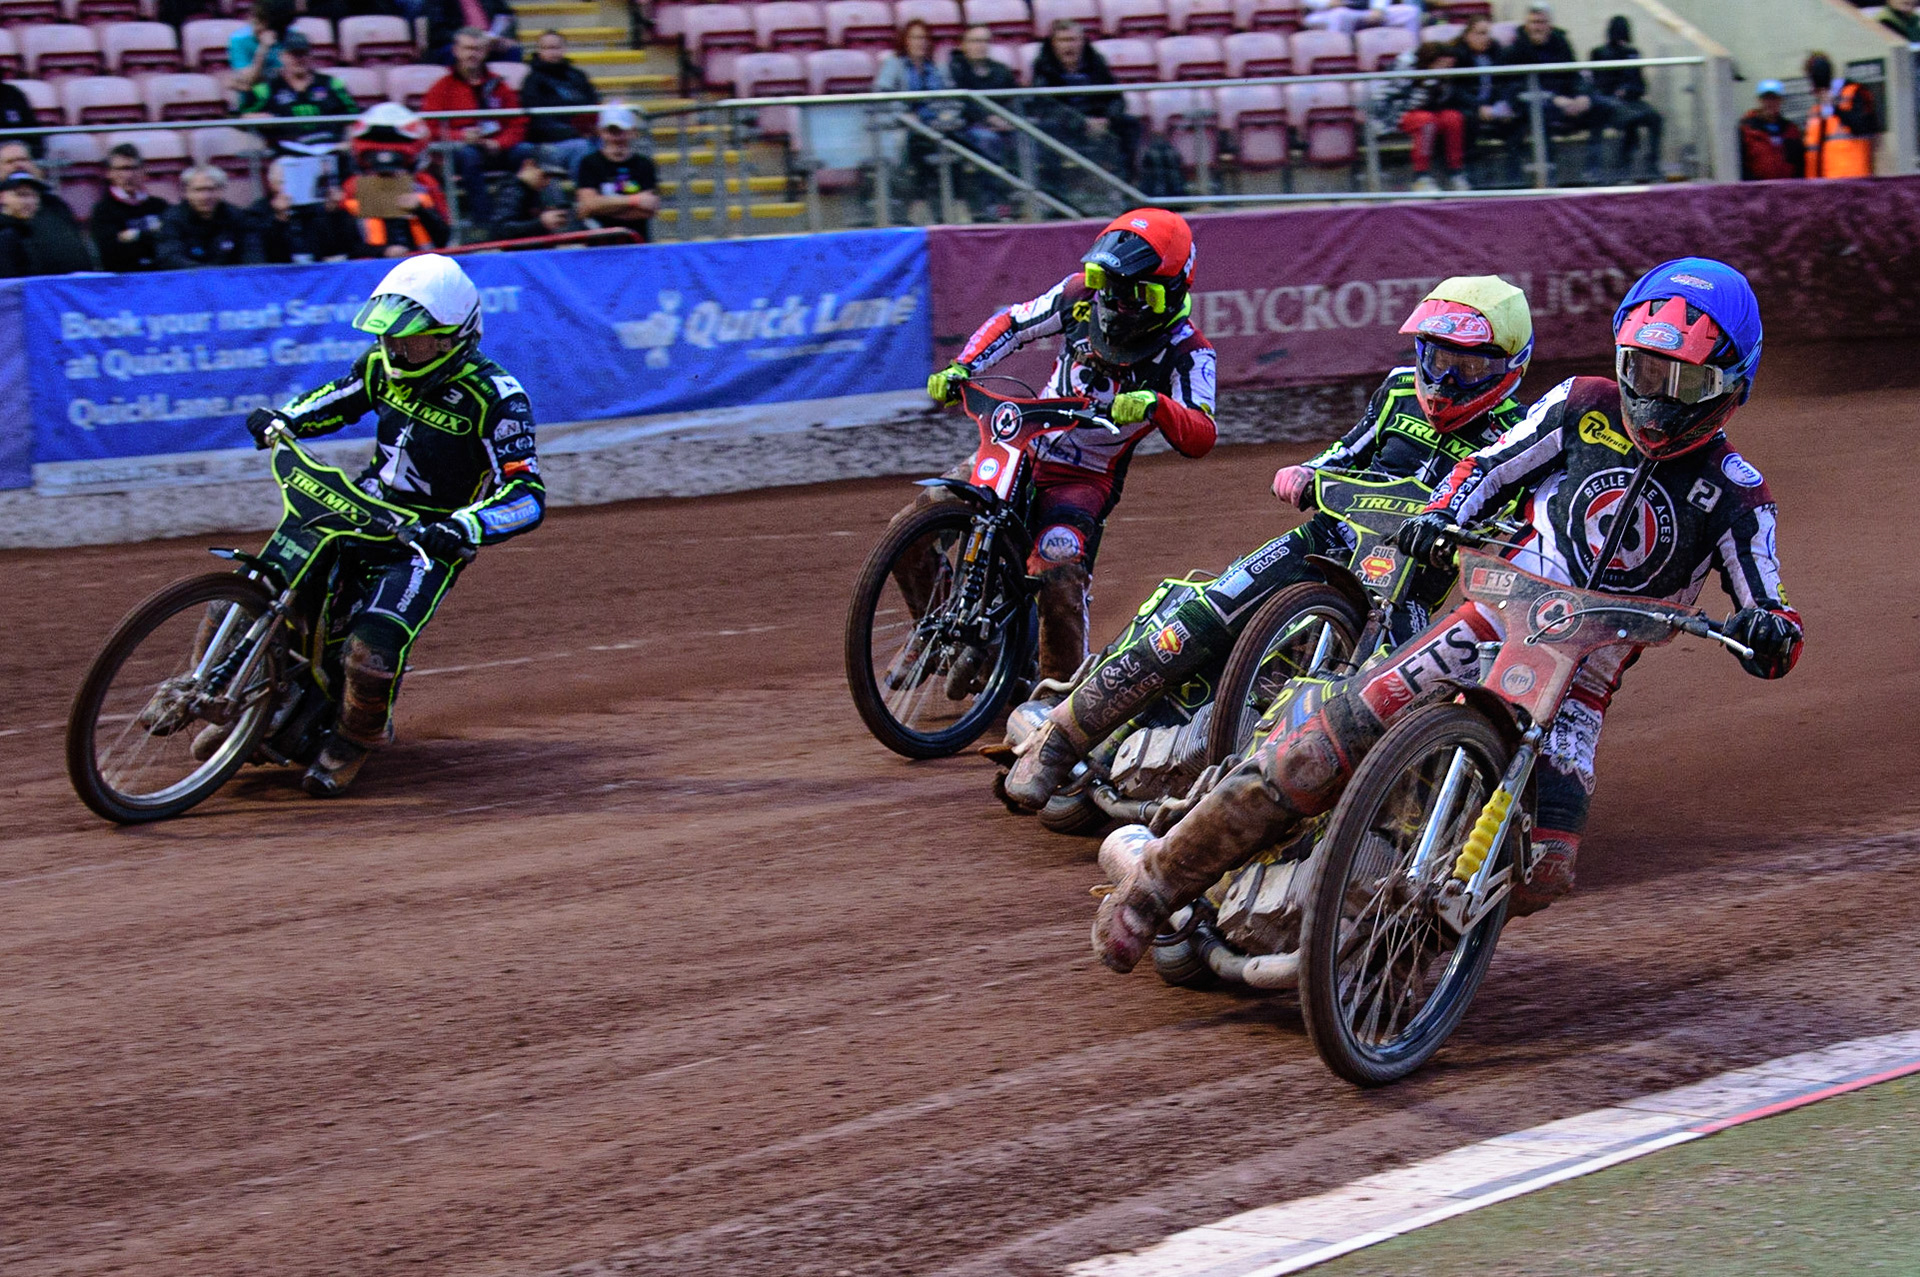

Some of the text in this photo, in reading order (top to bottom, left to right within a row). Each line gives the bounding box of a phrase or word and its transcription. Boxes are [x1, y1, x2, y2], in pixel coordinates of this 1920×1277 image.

[60, 286, 521, 340] Book your next Servi OT
[684, 292, 918, 349] Quick Lane
[1640, 329, 1675, 343] STS
[65, 352, 99, 380] at
[101, 346, 193, 380] Quick
[195, 343, 268, 371] Lane
[442, 388, 464, 405] 3
[418, 405, 462, 432] MIX
[1583, 415, 1629, 450] Rentruck
[293, 472, 360, 520] TRU MIX
[1583, 474, 1626, 500] BELLE
[1691, 480, 1717, 511] 2
[486, 503, 537, 527] Thermo
[1358, 496, 1399, 511] TRU
[1654, 504, 1671, 545] ACES
[1045, 537, 1073, 548] ATPI
[1372, 548, 1394, 558] SUE
[1251, 545, 1290, 574] GLASS
[1485, 571, 1514, 588] FTS
[1397, 627, 1479, 694] FTS
